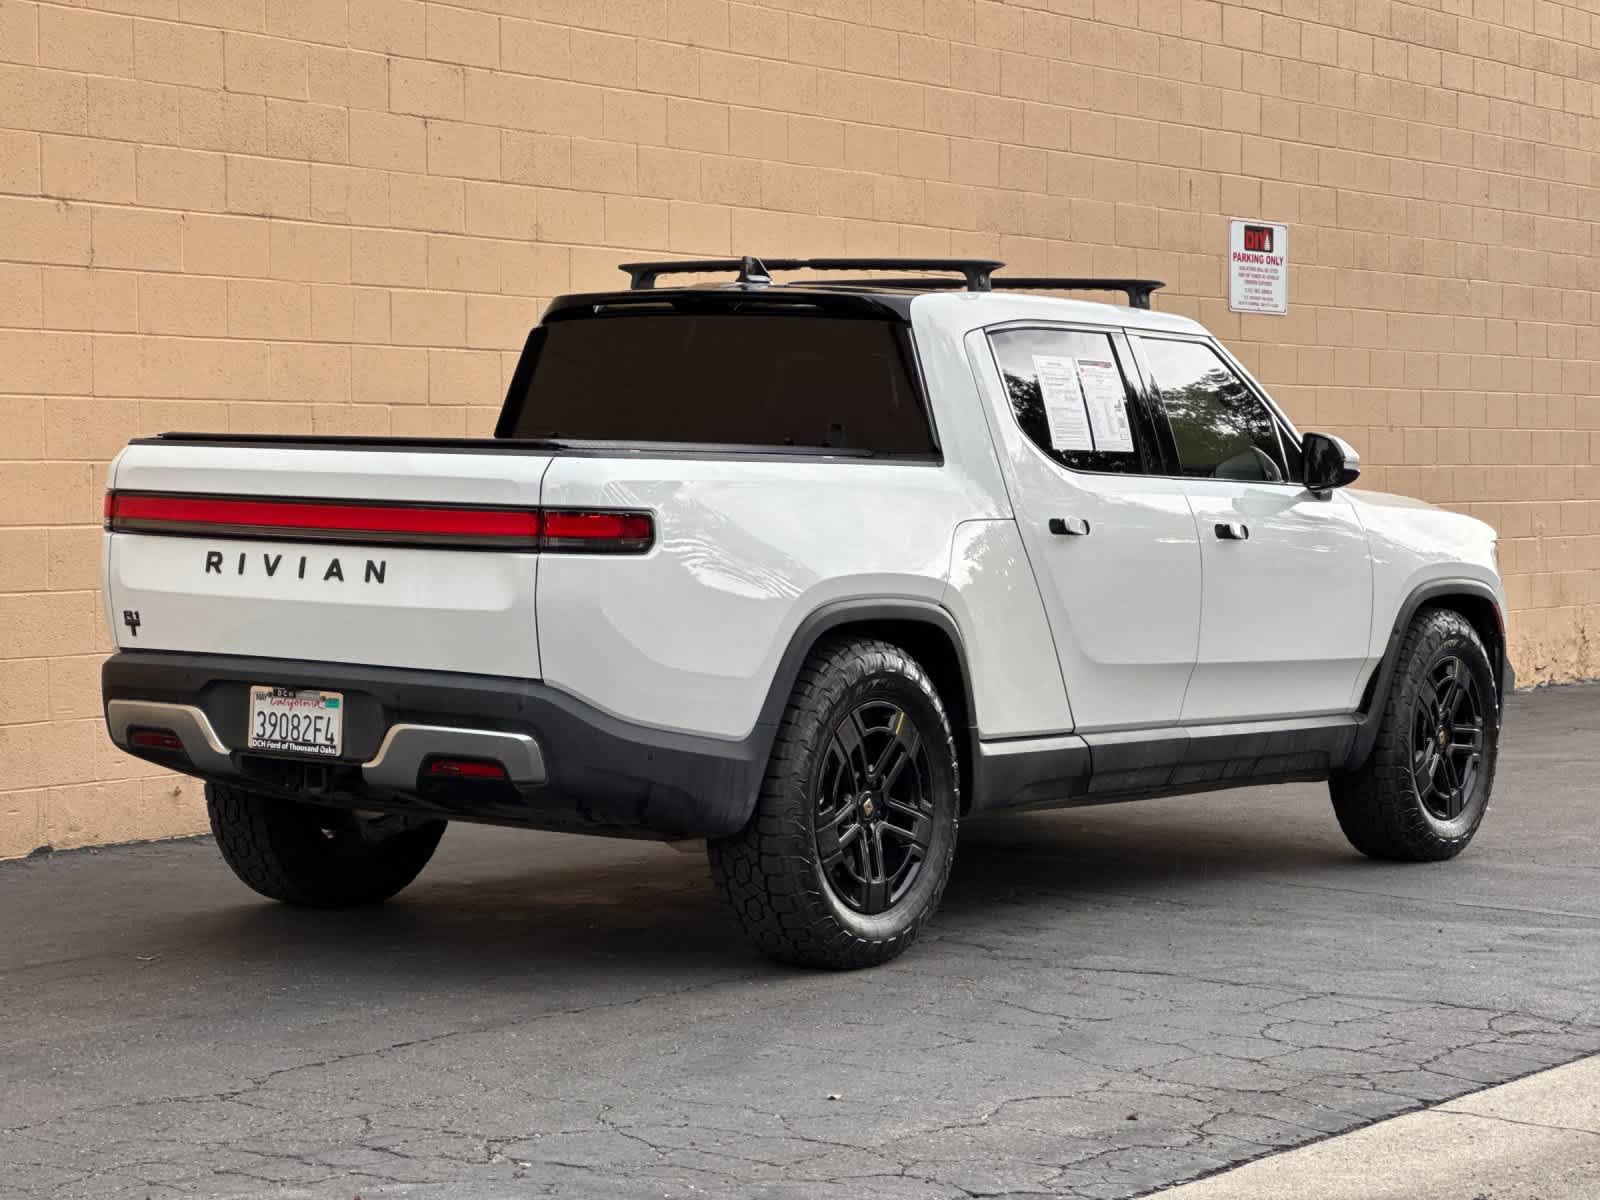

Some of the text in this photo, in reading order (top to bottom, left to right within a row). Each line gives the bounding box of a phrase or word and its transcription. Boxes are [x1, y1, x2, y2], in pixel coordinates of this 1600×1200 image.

[1233, 252, 1283, 266] PARKING ONLY
[205, 551, 386, 584] RIVIAN
[256, 711, 335, 745] 39082F4
[252, 740, 336, 755] DCH Ford of Thousand Oaks
